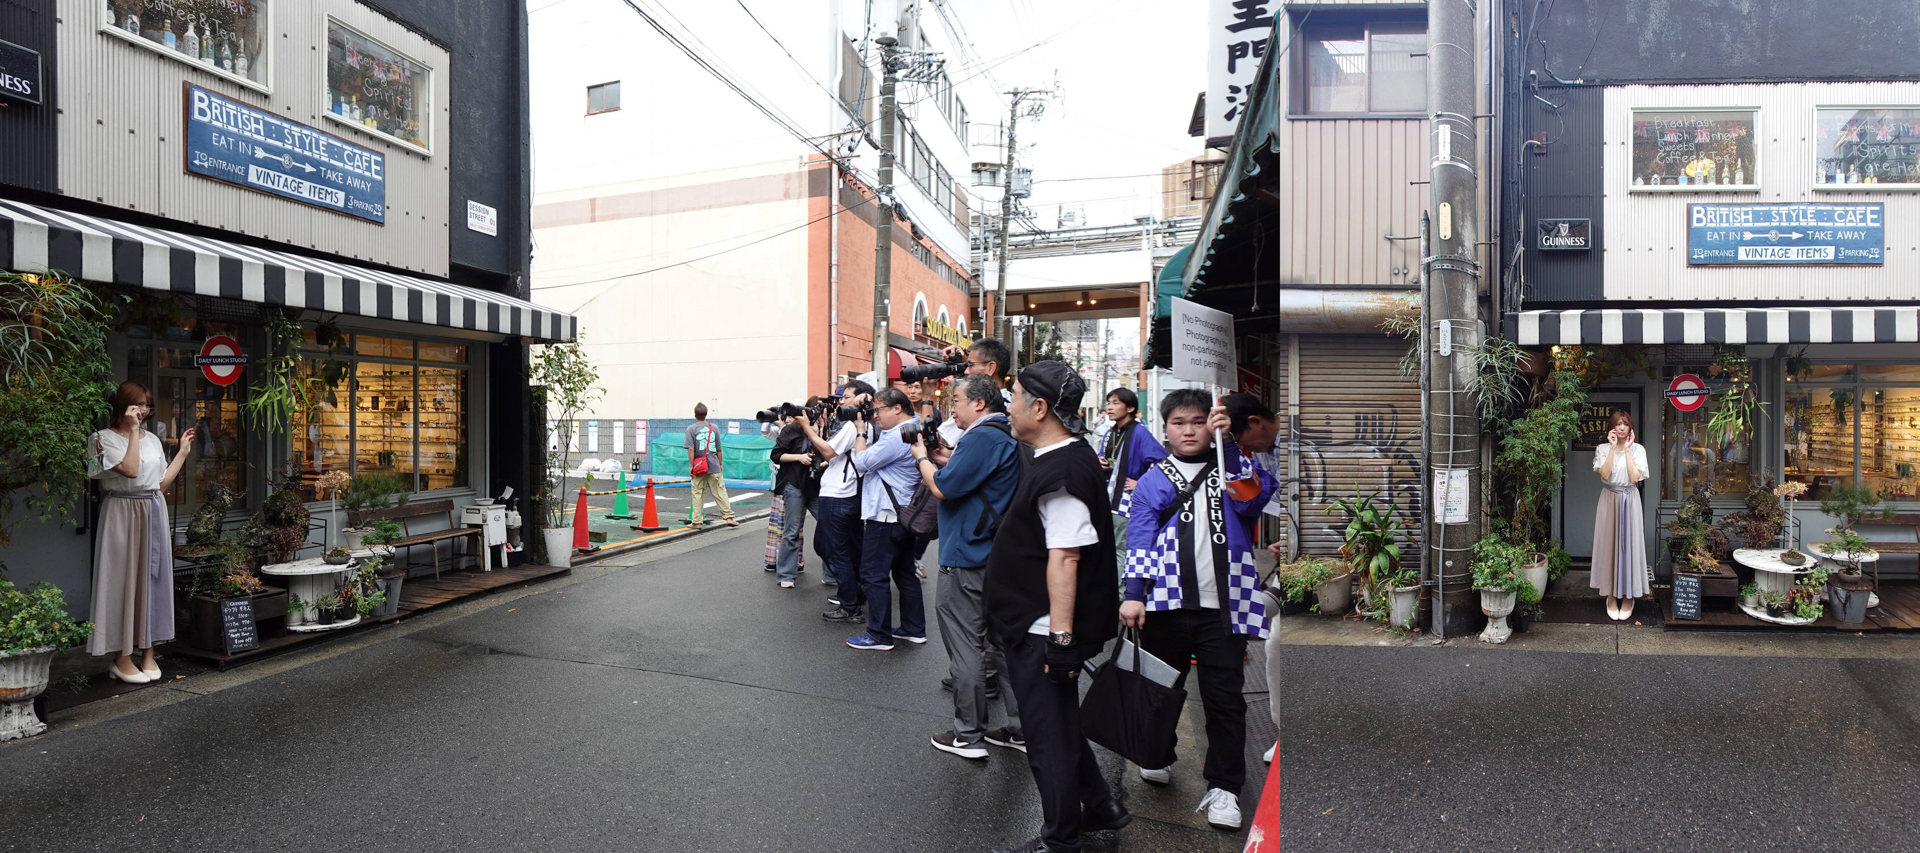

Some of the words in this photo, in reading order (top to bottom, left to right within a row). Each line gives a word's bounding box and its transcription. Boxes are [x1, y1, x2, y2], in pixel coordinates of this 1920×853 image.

[143, 0, 197, 25] Coffee
[199, 12, 209, 28] &
[210, 17, 237, 43] Tea
[362, 77, 413, 111] Spirits
[193, 89, 265, 137] BRITISH
[284, 129, 329, 158] STYLE
[343, 151, 383, 181] CAFE
[1657, 141, 1696, 152] Sweets
[1857, 142, 1917, 160] Spirits
[194, 151, 208, 161] TO
[208, 157, 246, 177] ENTRANCE
[212, 132, 235, 150] EAT
[238, 141, 252, 156] IN
[319, 166, 344, 184] TAKE
[346, 173, 372, 193] AWAY
[1656, 150, 1697, 164] Coffee
[1699, 150, 1707, 161] &
[1708, 151, 1730, 164] Tea
[1864, 161, 1892, 177] are
[255, 168, 304, 196] VINTAGE
[308, 184, 339, 204] ITEMS
[353, 199, 374, 213] PARKING
[469, 202, 490, 216] SESSION
[469, 212, 486, 223] STREET
[1692, 205, 1753, 227] BRITISH
[1771, 209, 1817, 223] STYLE
[1834, 206, 1881, 227] CAFE
[1542, 235, 1585, 246] GUINNESS
[1706, 231, 1726, 241] EAT
[1729, 231, 1741, 241] IN
[1807, 230, 1833, 240] TAKE
[1836, 230, 1867, 240] AWAY
[1704, 249, 1735, 257] ENTRANCE
[1744, 247, 1791, 259] VINTAGE
[1796, 247, 1829, 259] ITEMS
[1845, 249, 1869, 257] PARKING
[1185, 328, 1222, 348] Photography
[1182, 342, 1228, 361] non-participants
[1190, 357, 1203, 366] not
[1592, 406, 1611, 417] THE
[1158, 459, 1194, 523] KOMEYO
[1207, 466, 1227, 545] KOMEHYO
